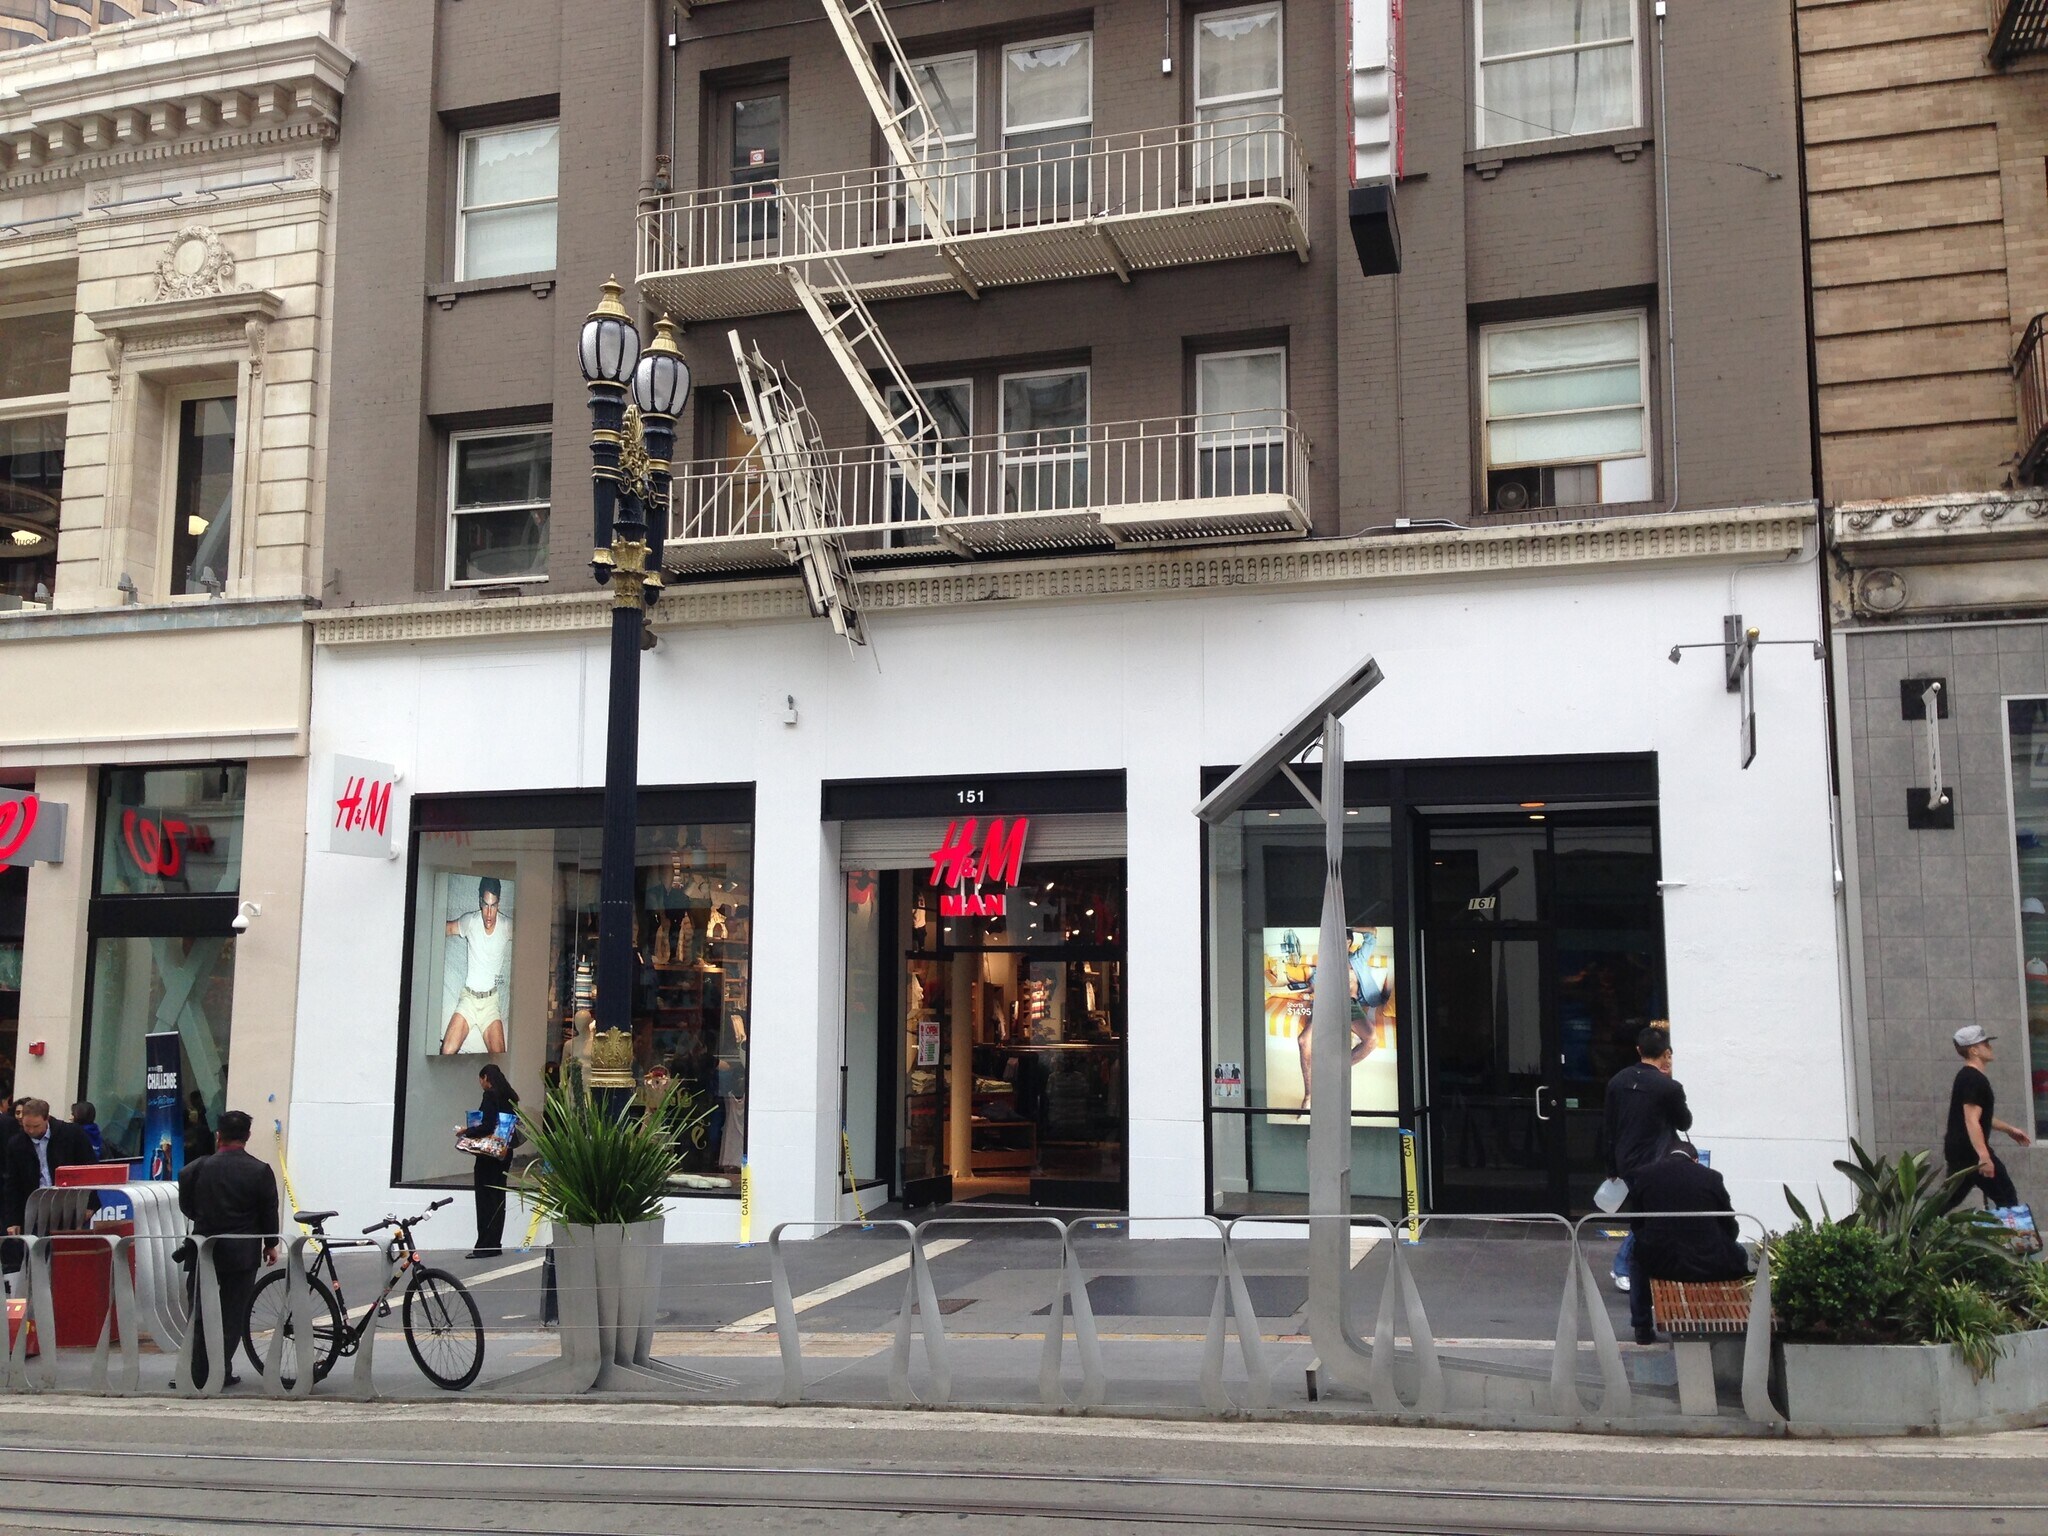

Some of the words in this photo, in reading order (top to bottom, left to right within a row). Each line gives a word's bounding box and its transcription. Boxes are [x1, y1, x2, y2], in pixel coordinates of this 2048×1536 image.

[336, 776, 392, 837] H&M
[957, 790, 984, 803] 151
[929, 817, 1029, 888] H&M
[940, 894, 1006, 916] MAN
[1471, 899, 1493, 909] 161
[147, 1072, 177, 1090] CHALLENGE
